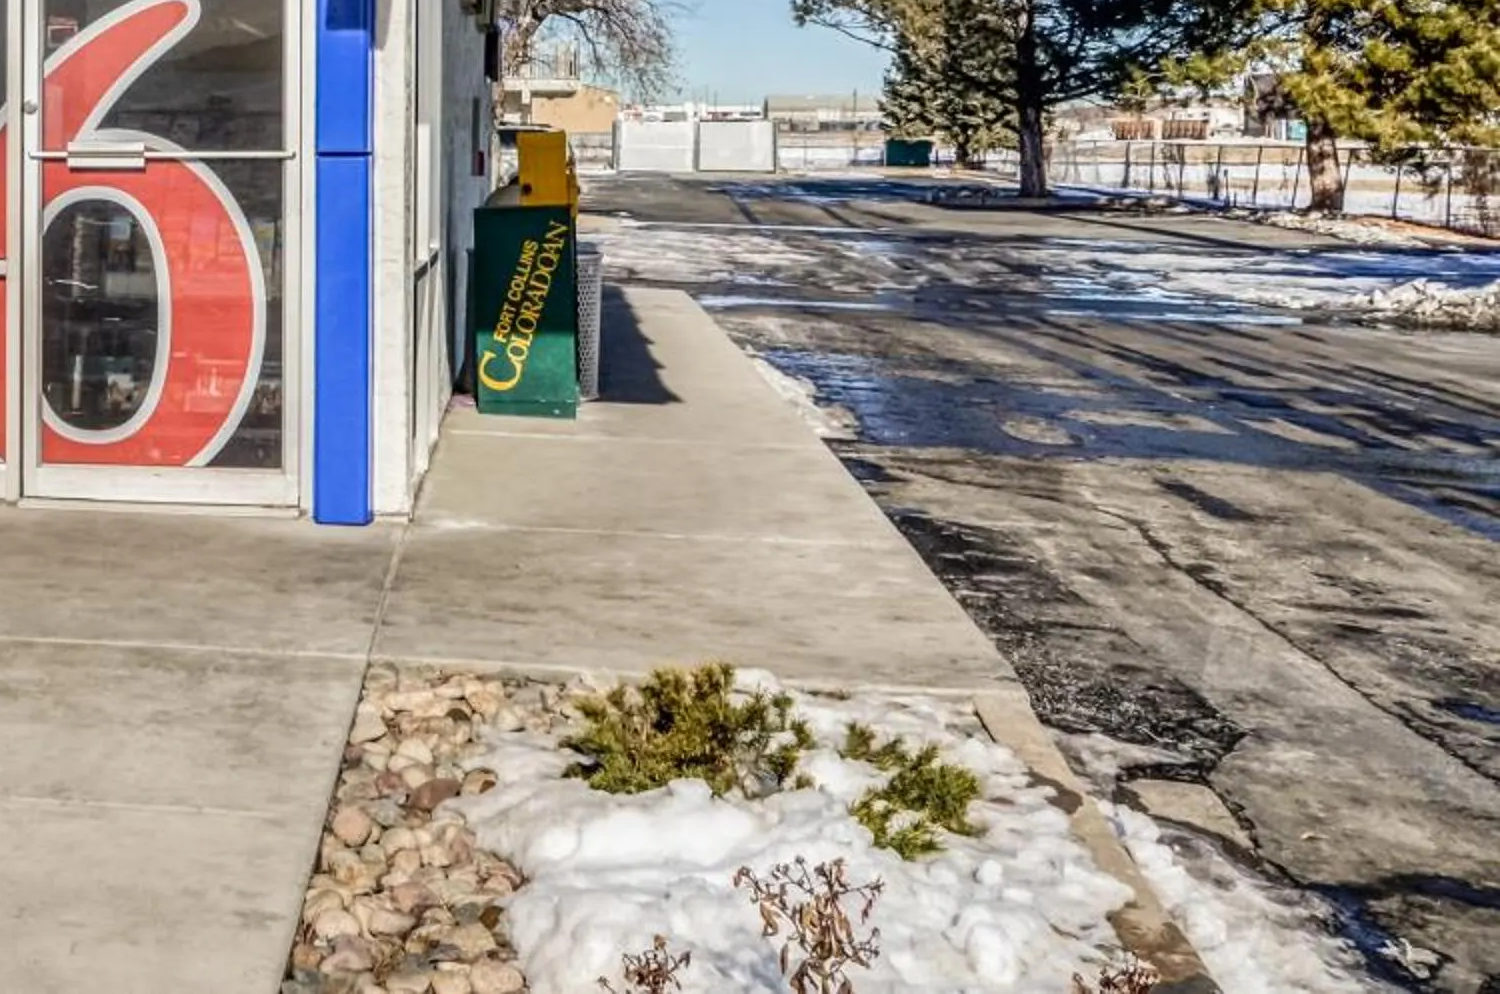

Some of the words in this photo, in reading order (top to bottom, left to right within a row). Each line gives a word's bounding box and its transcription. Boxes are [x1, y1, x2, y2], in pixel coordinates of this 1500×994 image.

[478, 220, 570, 391] COLORADOAN
[493, 302, 517, 343] FORT
[507, 239, 540, 302] COLLINS
